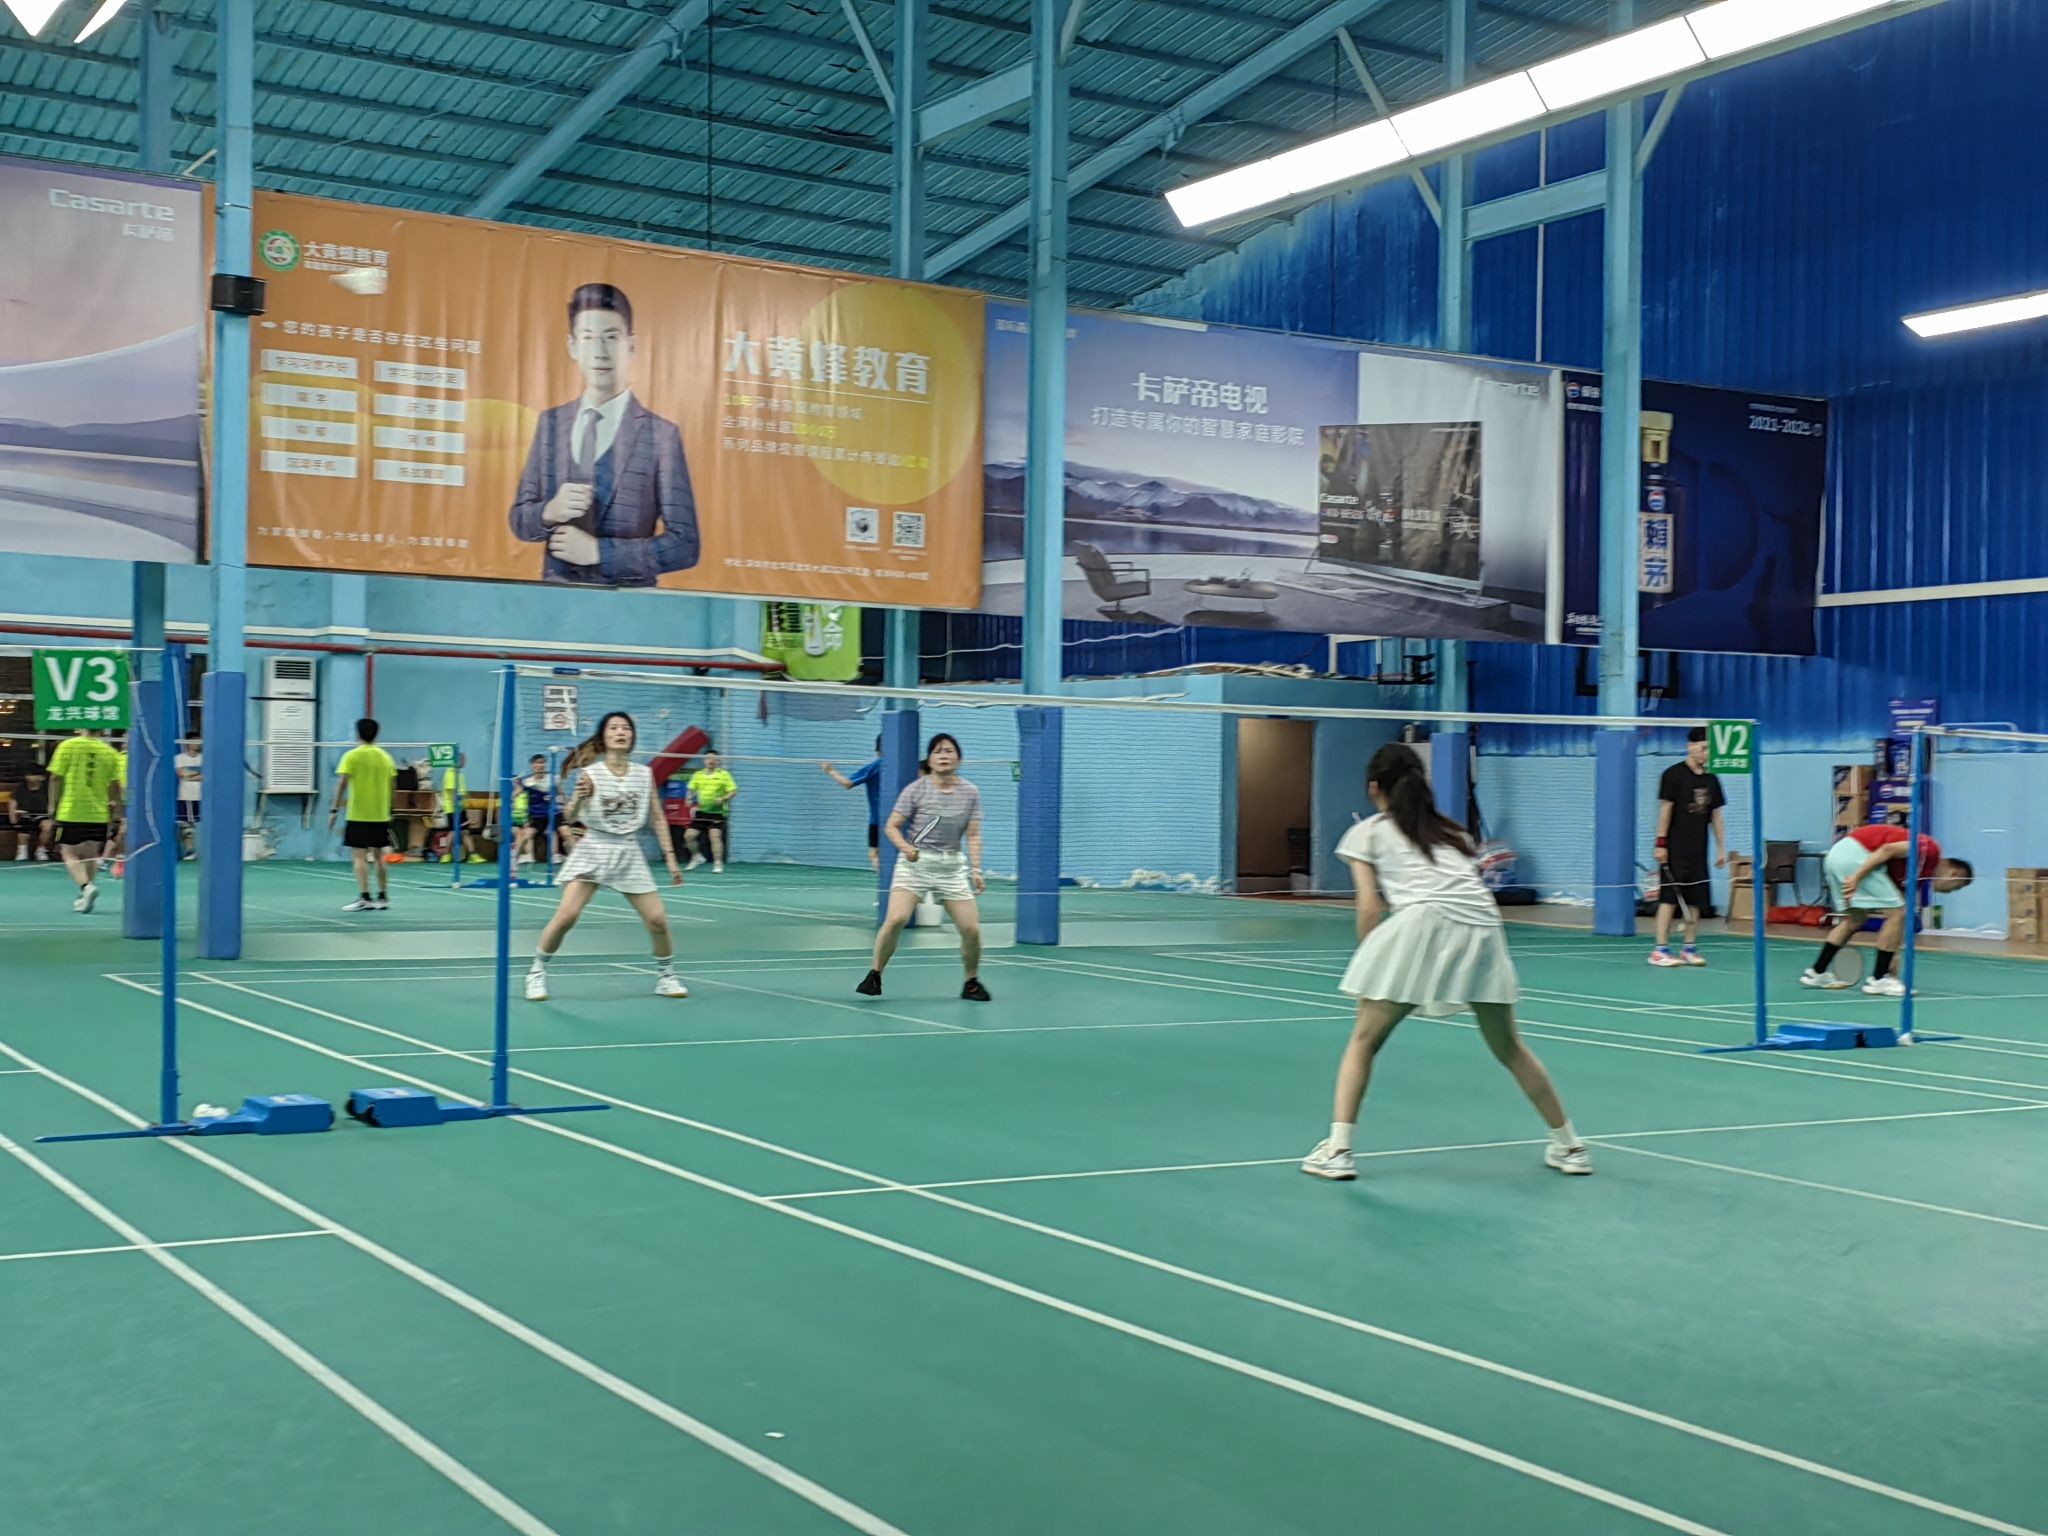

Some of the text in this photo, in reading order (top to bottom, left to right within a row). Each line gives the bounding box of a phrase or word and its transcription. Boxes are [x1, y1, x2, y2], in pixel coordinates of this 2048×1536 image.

[49, 187, 175, 221] Casarte
[723, 331, 931, 395] 大黄蜂教育
[1131, 371, 1269, 414] 卡萨帝电视
[1090, 405, 1305, 446] 打造专属你的智慧家庭影院
[44, 656, 119, 702] V3
[1712, 724, 1749, 755] V2
